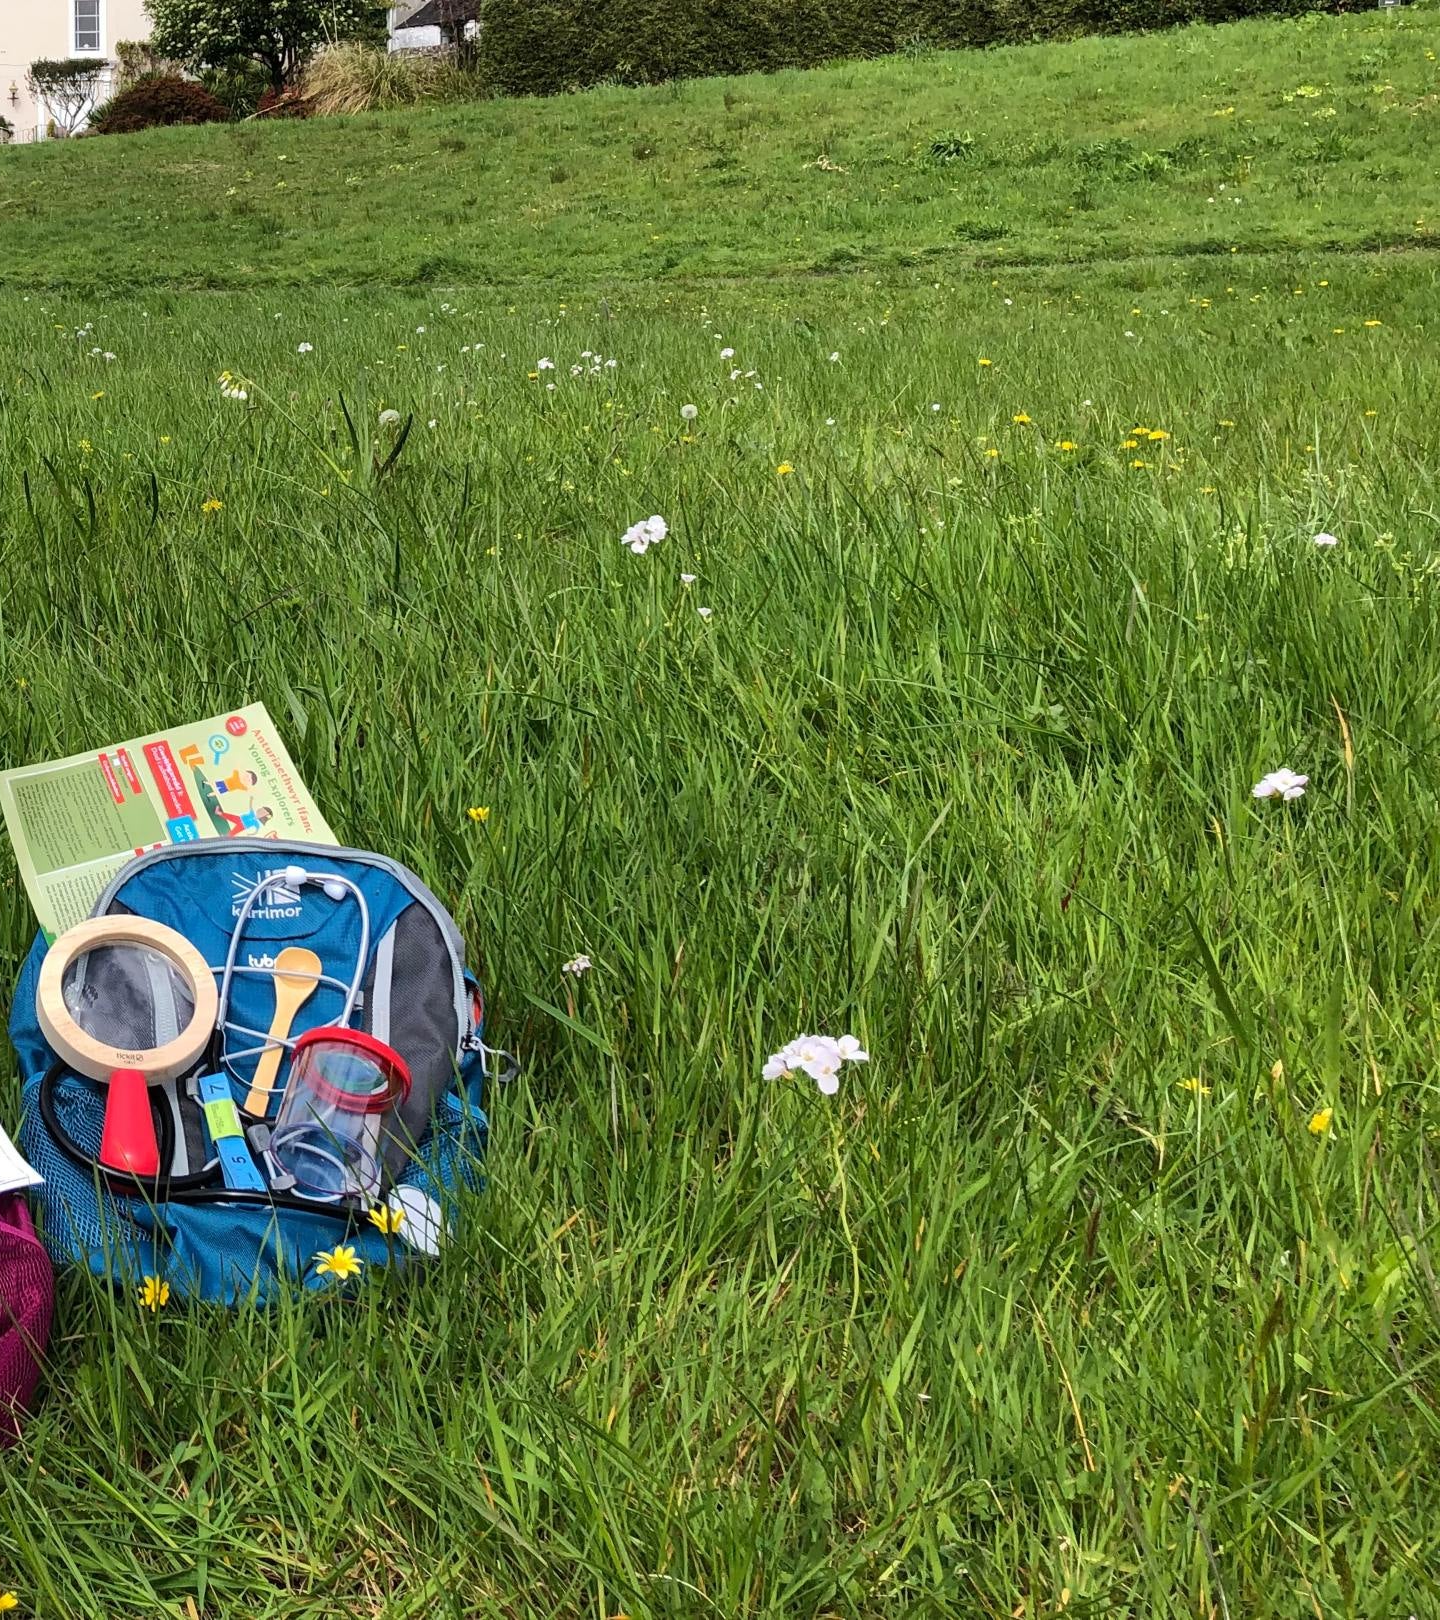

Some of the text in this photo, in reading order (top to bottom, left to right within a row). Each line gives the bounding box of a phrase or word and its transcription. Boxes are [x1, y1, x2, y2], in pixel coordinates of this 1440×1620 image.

[247, 743, 295, 826] Young Explorers
[251, 730, 313, 833] Anturiaethwyr Ifanc
[232, 905, 303, 919] krrimor
[248, 954, 277, 968] tub
